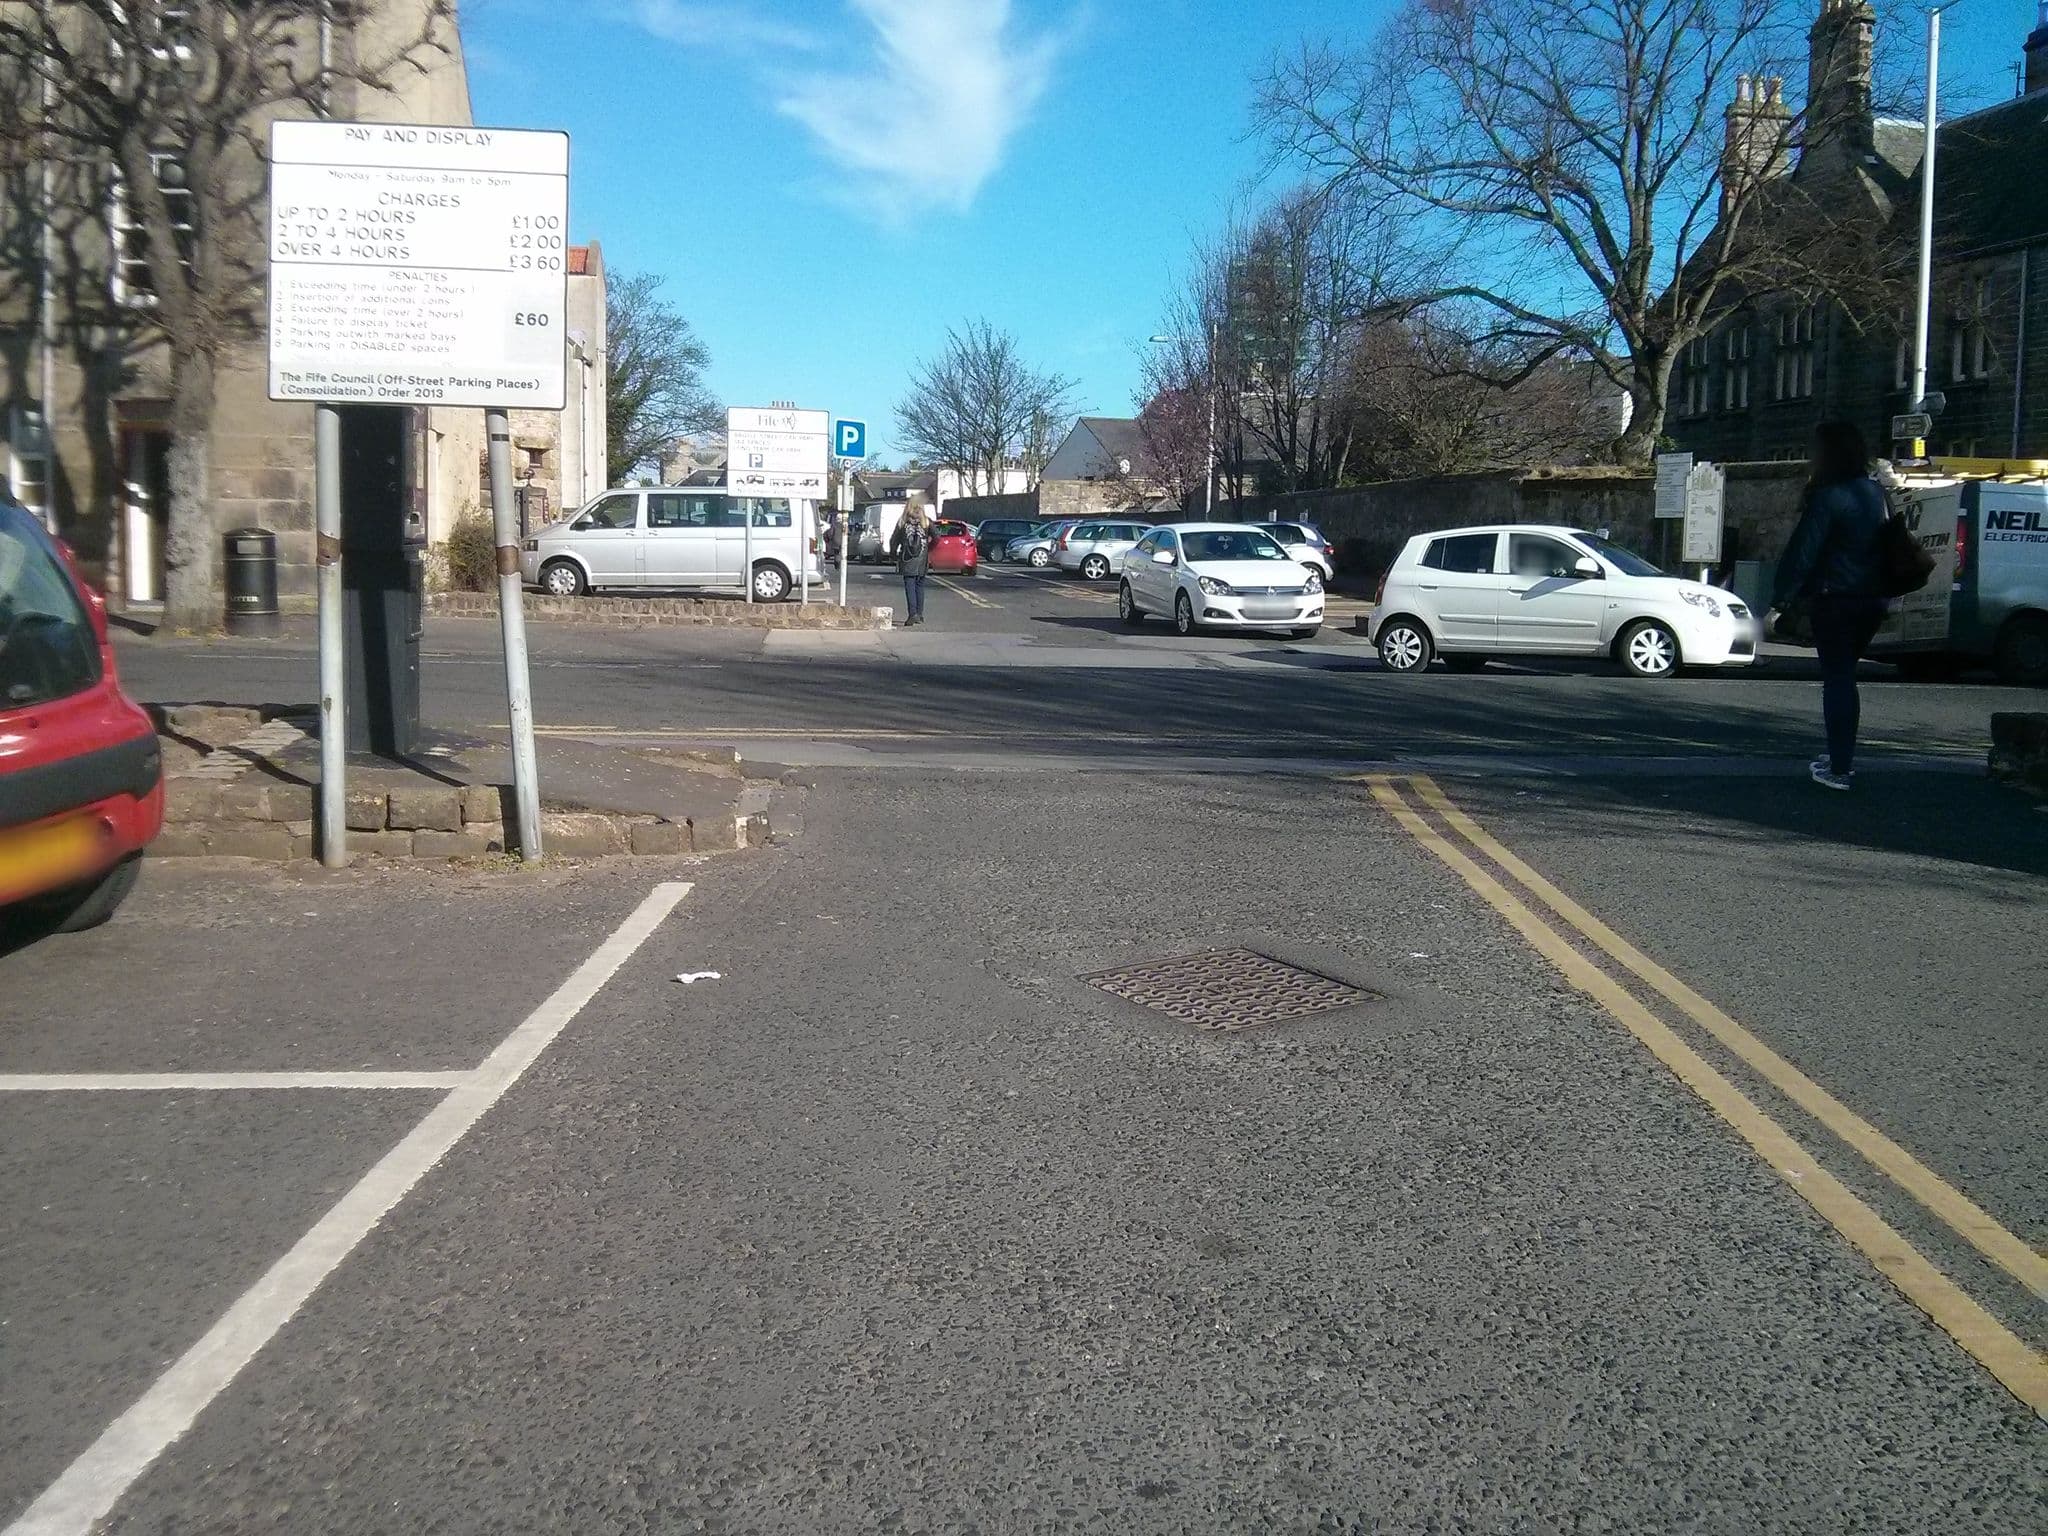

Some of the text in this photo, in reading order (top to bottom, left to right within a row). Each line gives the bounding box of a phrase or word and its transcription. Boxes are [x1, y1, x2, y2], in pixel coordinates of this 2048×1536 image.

[344, 127, 493, 146] PAY AND DISPLAY
[328, 169, 370, 182] Monday
[387, 172, 435, 184] Saturday
[441, 174, 466, 184] 9am
[471, 176, 482, 186] to
[487, 176, 511, 188] 5pm
[378, 191, 461, 208] CHARGES
[277, 206, 299, 219] UP
[307, 207, 328, 221] TO
[338, 208, 347, 221] 2
[355, 209, 416, 224] HOURS
[279, 223, 288, 237] 2
[296, 224, 318, 238] TO
[326, 226, 337, 239] 4
[345, 227, 406, 241] HOURS
[278, 241, 322, 257] OVER
[331, 244, 342, 257] 4
[350, 245, 410, 260] HOURS
[388, 270, 448, 282] PENALTIES
[289, 279, 347, 292] Exceeding
[352, 281, 376, 292] time
[361, 295, 417, 305] additional
[290, 303, 348, 315] Exceeding
[352, 306, 377, 316] time
[290, 314, 329, 326] Failure
[334, 317, 345, 326] to
[350, 318, 389, 330] display
[395, 319, 429, 329] ticket
[514, 312, 549, 327] £60
[290, 327, 331, 339] Parking
[335, 329, 379, 339] outwith
[385, 331, 426, 341] marked
[430, 332, 457, 343] bays
[290, 339, 331, 351] Parking
[336, 341, 346, 350] in
[350, 340, 406, 352] DISABLED
[411, 344, 451, 355] spaces
[280, 371, 301, 382] The
[305, 372, 327, 383] Fife
[331, 372, 374, 385] Council
[448, 377, 492, 390] Parking
[496, 379, 541, 391] Places)
[280, 384, 444, 399] (Consolidation) Order 2013
[842, 425, 859, 451] P
[1985, 510, 2048, 531] NEIL
[1919, 533, 1951, 548] RTIN
